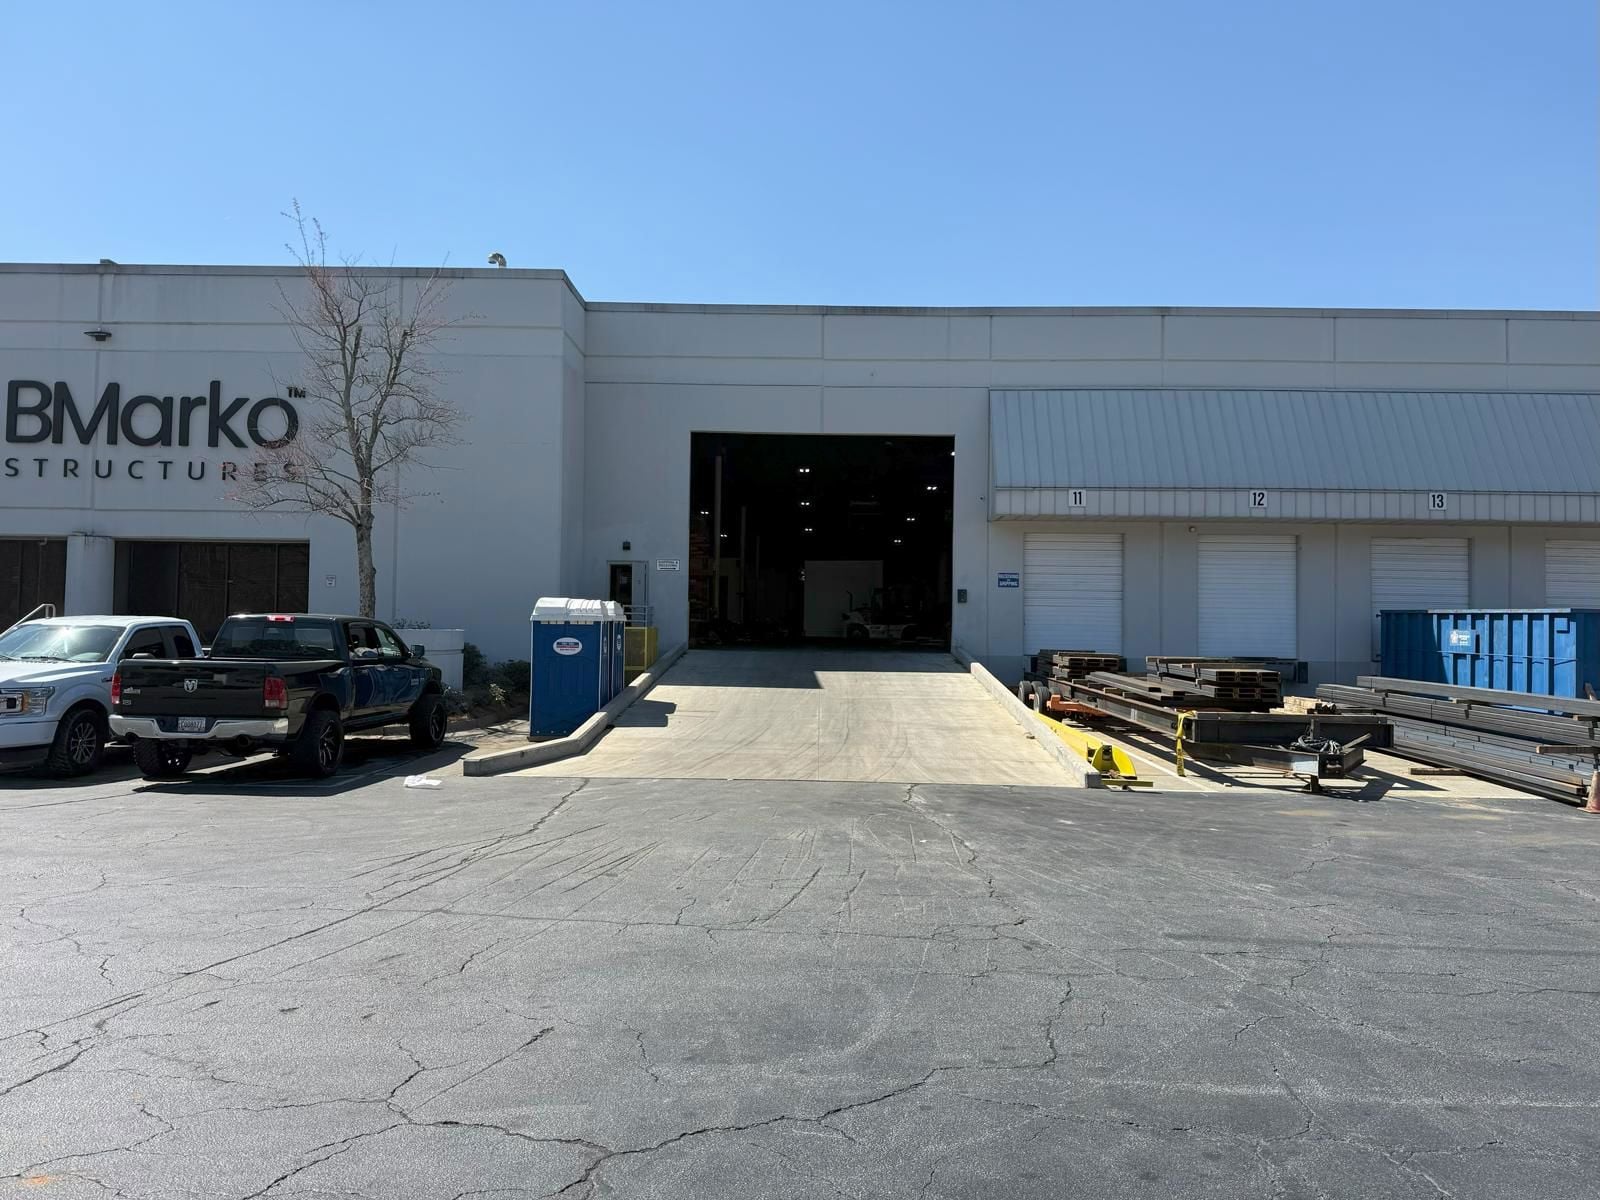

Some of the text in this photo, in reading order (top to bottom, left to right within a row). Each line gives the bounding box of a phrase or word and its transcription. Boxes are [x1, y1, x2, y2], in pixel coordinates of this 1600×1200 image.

[5, 380, 299, 449] BMarko
[1072, 491, 1082, 505] 11
[1252, 492, 1265, 506] 12
[1431, 494, 1444, 508] 13
